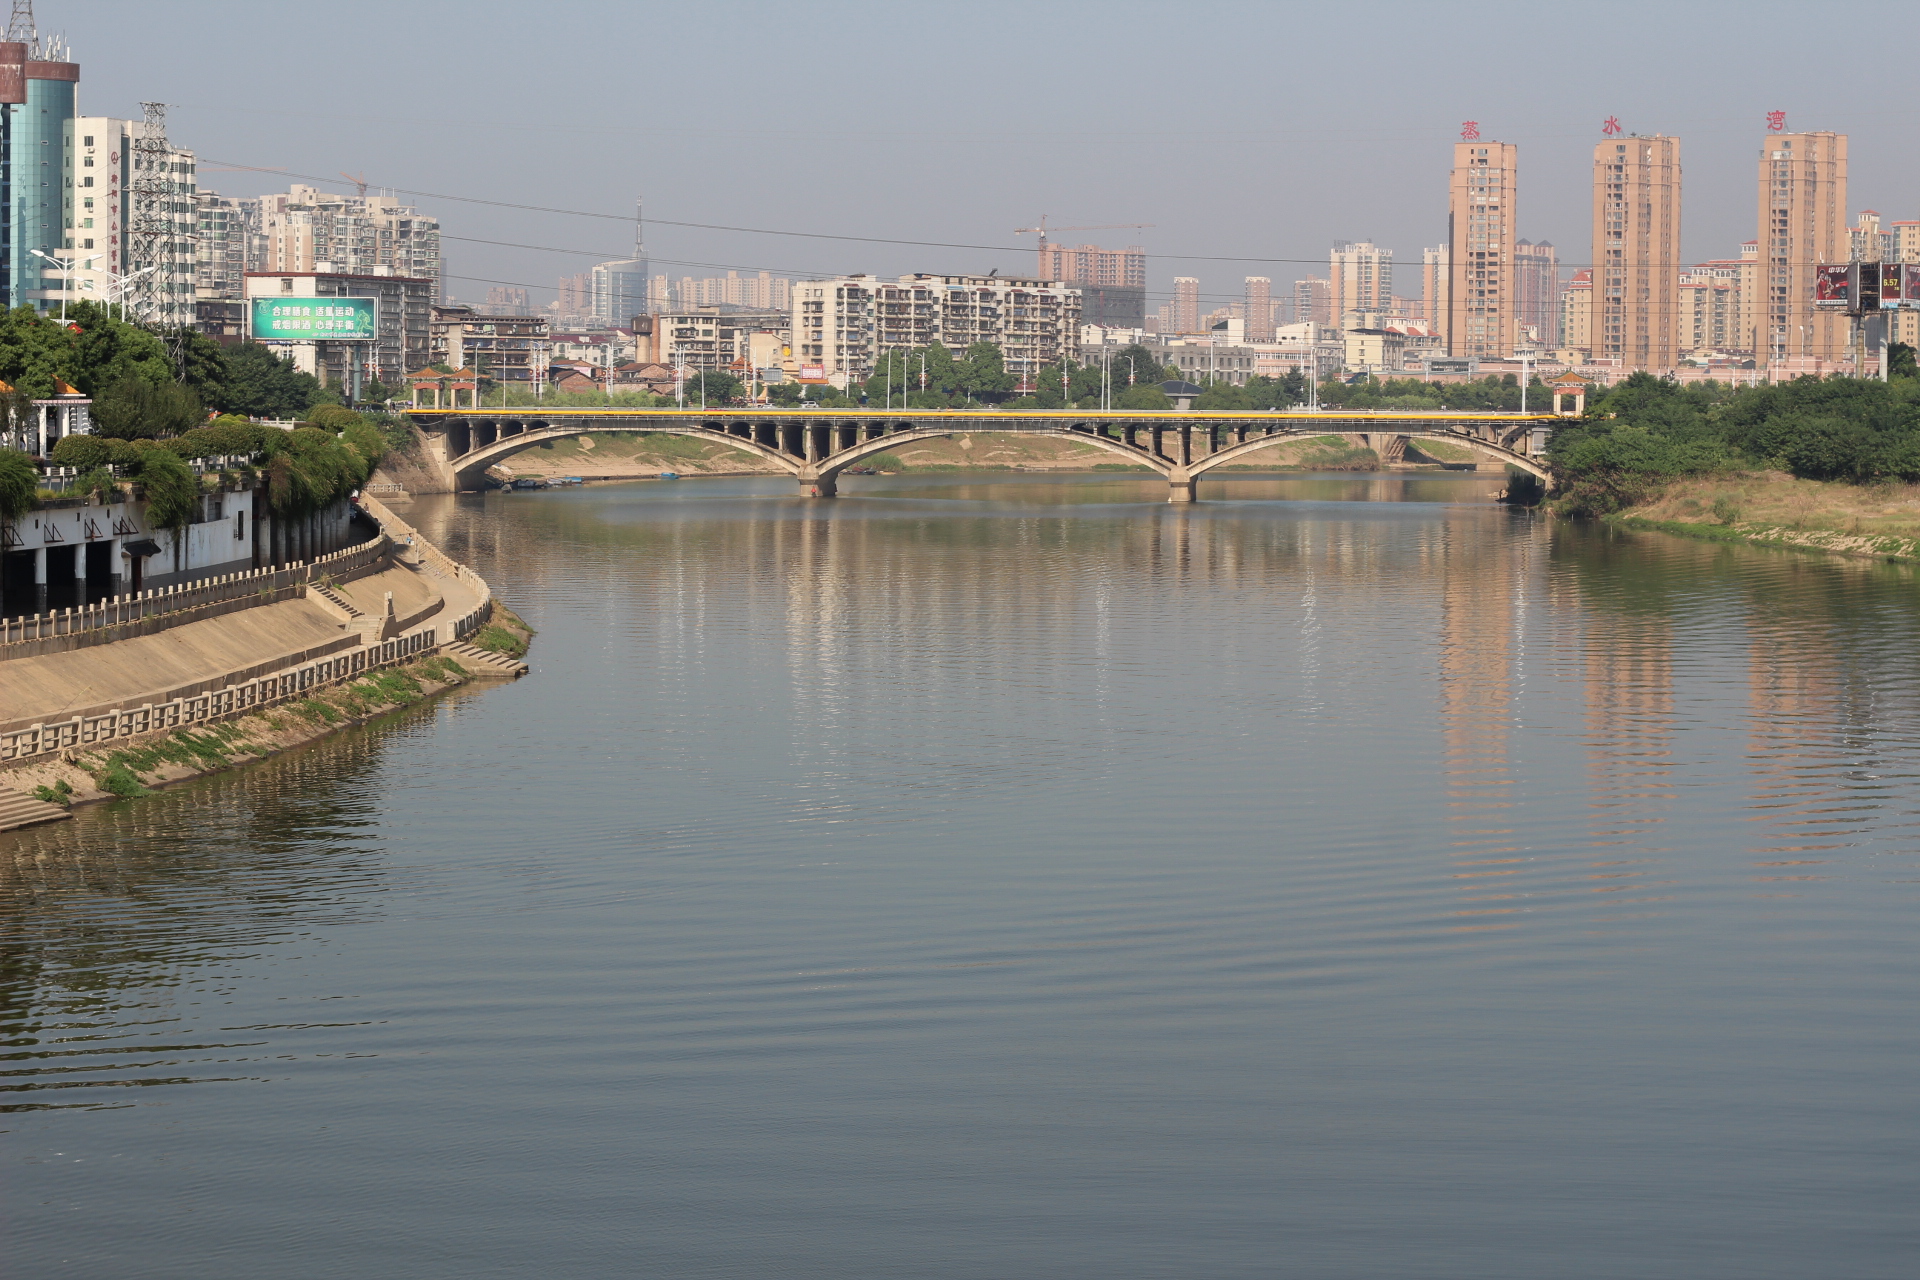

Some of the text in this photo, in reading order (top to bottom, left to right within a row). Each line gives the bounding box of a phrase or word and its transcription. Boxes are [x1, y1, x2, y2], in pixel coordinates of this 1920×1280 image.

[1602, 116, 1622, 136] 水
[1765, 111, 1786, 131] 湾
[1460, 121, 1481, 140] 蒸
[1883, 279, 1898, 287] 6.57
[272, 306, 354, 317] 合理膳食 适量运动
[272, 319, 354, 330] 戒烟限酒 心理平衡
